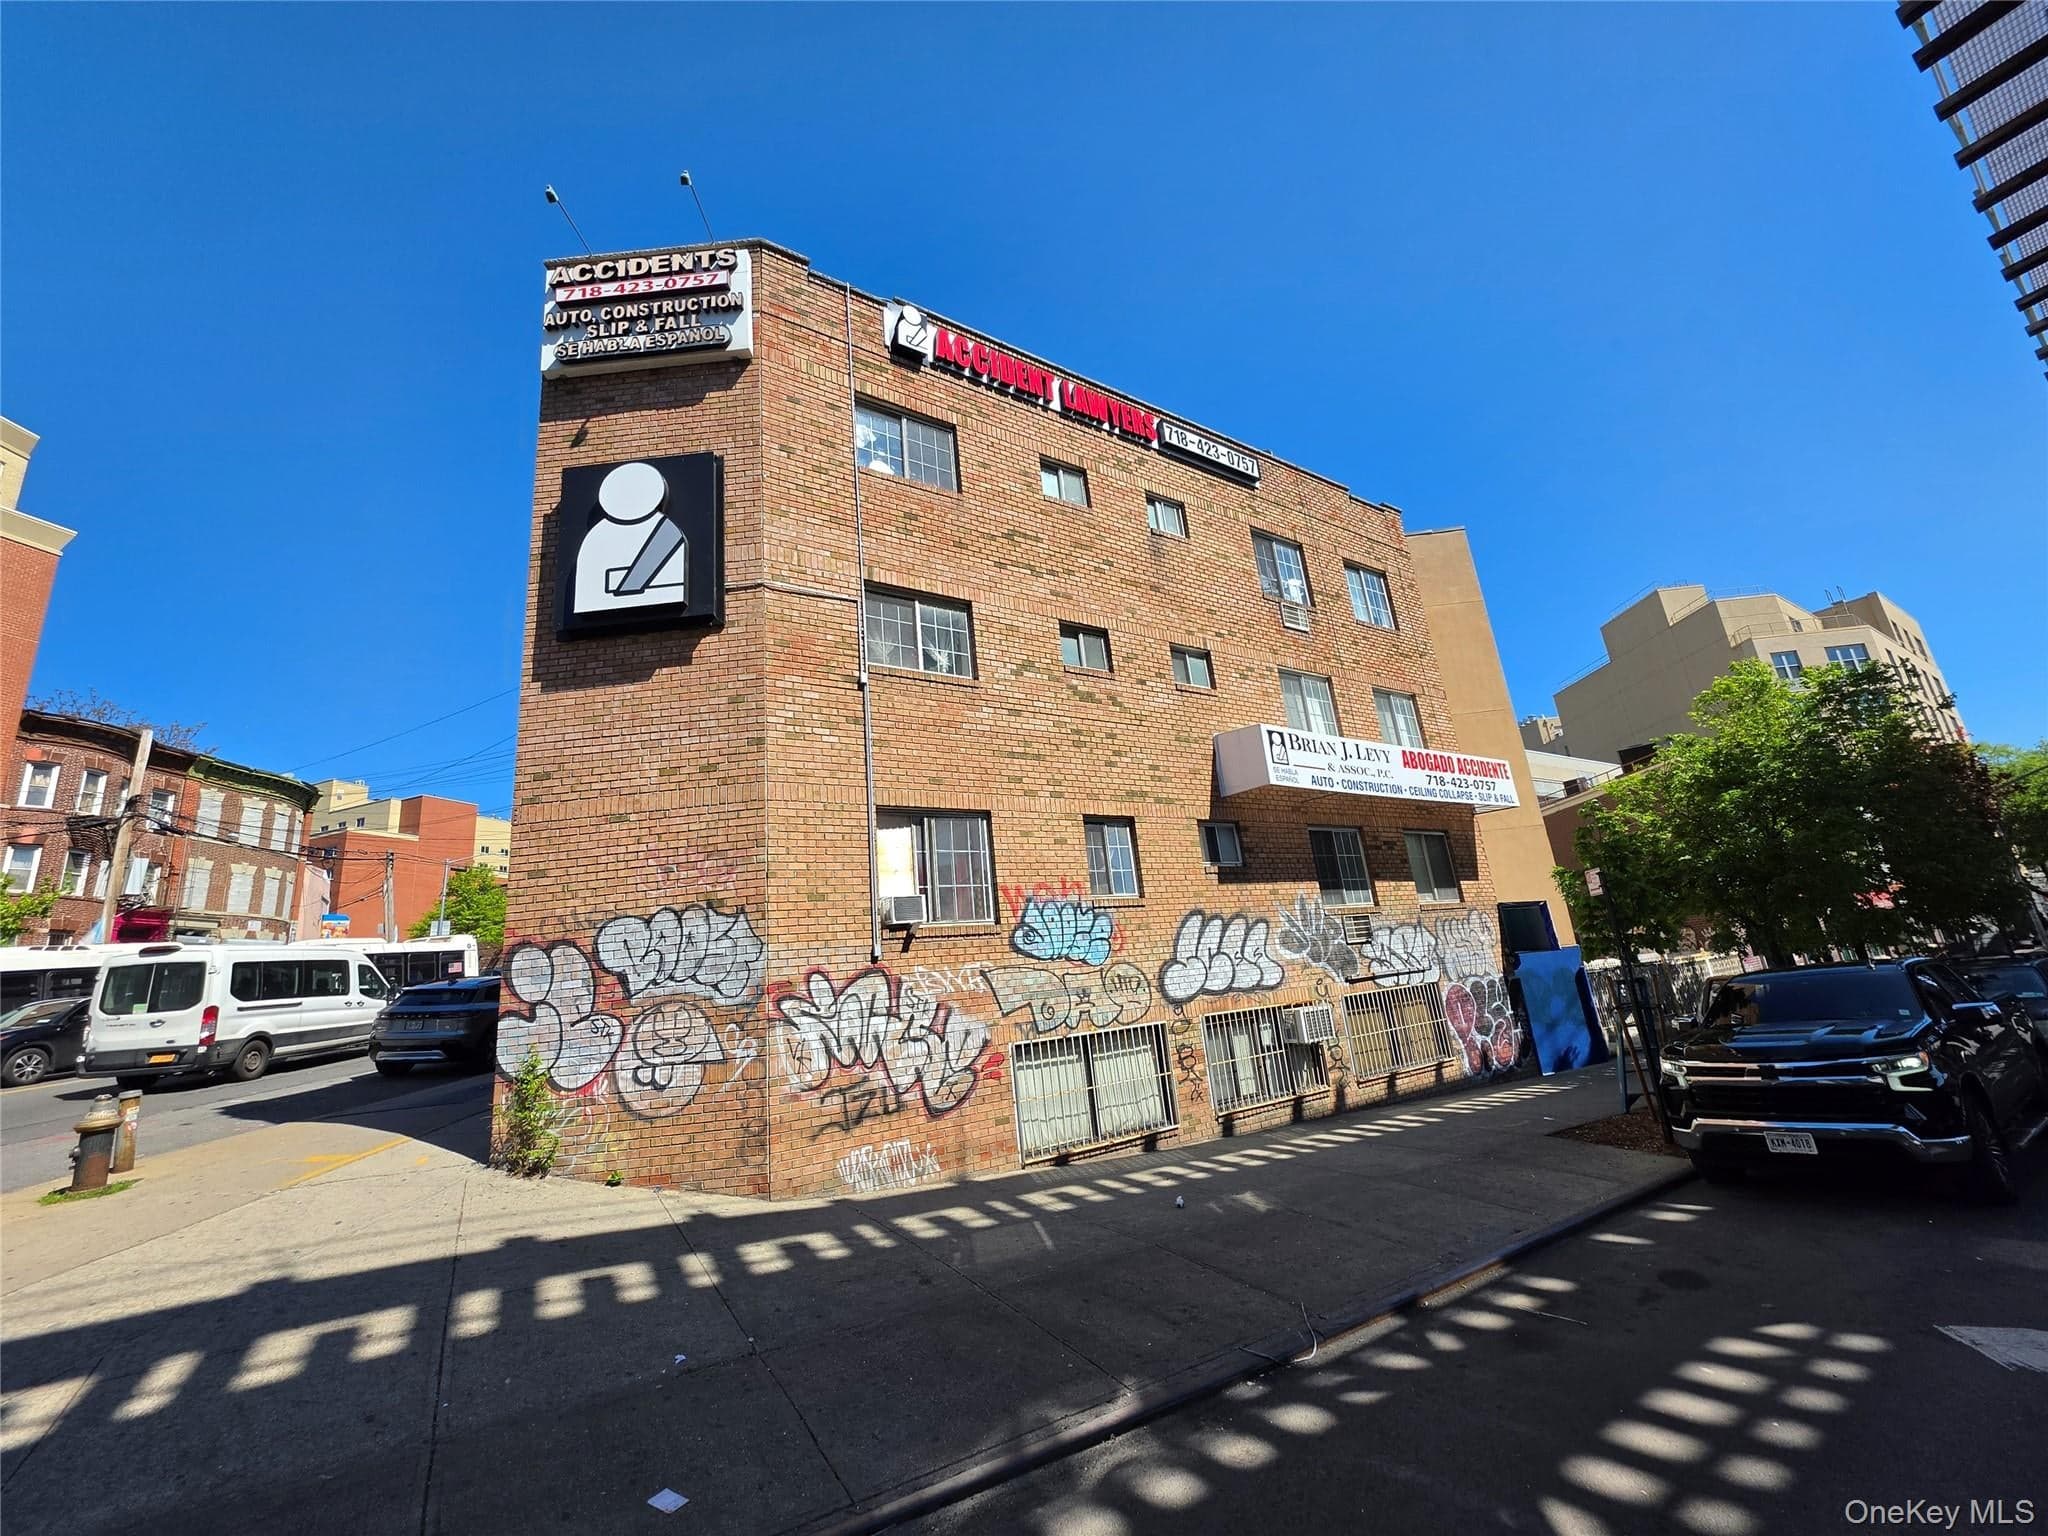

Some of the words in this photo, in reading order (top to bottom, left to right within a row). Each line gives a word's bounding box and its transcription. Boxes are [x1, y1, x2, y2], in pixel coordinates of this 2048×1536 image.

[551, 248, 737, 285] ACCIDENTS
[563, 272, 719, 300] 718-423-0757
[544, 308, 597, 327] AUTO,
[600, 292, 744, 321] CONSTRUCTION
[586, 322, 630, 339] SLIP
[636, 320, 649, 334] &
[654, 314, 702, 332] FALL
[556, 342, 579, 358] SE
[582, 336, 642, 355] HABLA
[934, 327, 1056, 402] ACCIDENT
[1060, 380, 1158, 443] LAWYERS
[1165, 424, 1257, 475] 718-423-0757
[1340, 741, 1353, 762] J.
[1401, 750, 1456, 774] ABOGADO
[1456, 758, 1511, 780] ACCIDENTE
[1281, 767, 1299, 776] HABLA
[1327, 762, 1336, 772] &
[1311, 775, 1335, 788] AUTO
[1341, 778, 1404, 794] CONSTRUCTION
[1408, 785, 1438, 798] CEILING
[1439, 789, 1474, 801] COLLAPSE
[1477, 792, 1493, 802] SLIP
[1499, 794, 1516, 805] FALL
[1425, 774, 1497, 792] 718-423-0757
